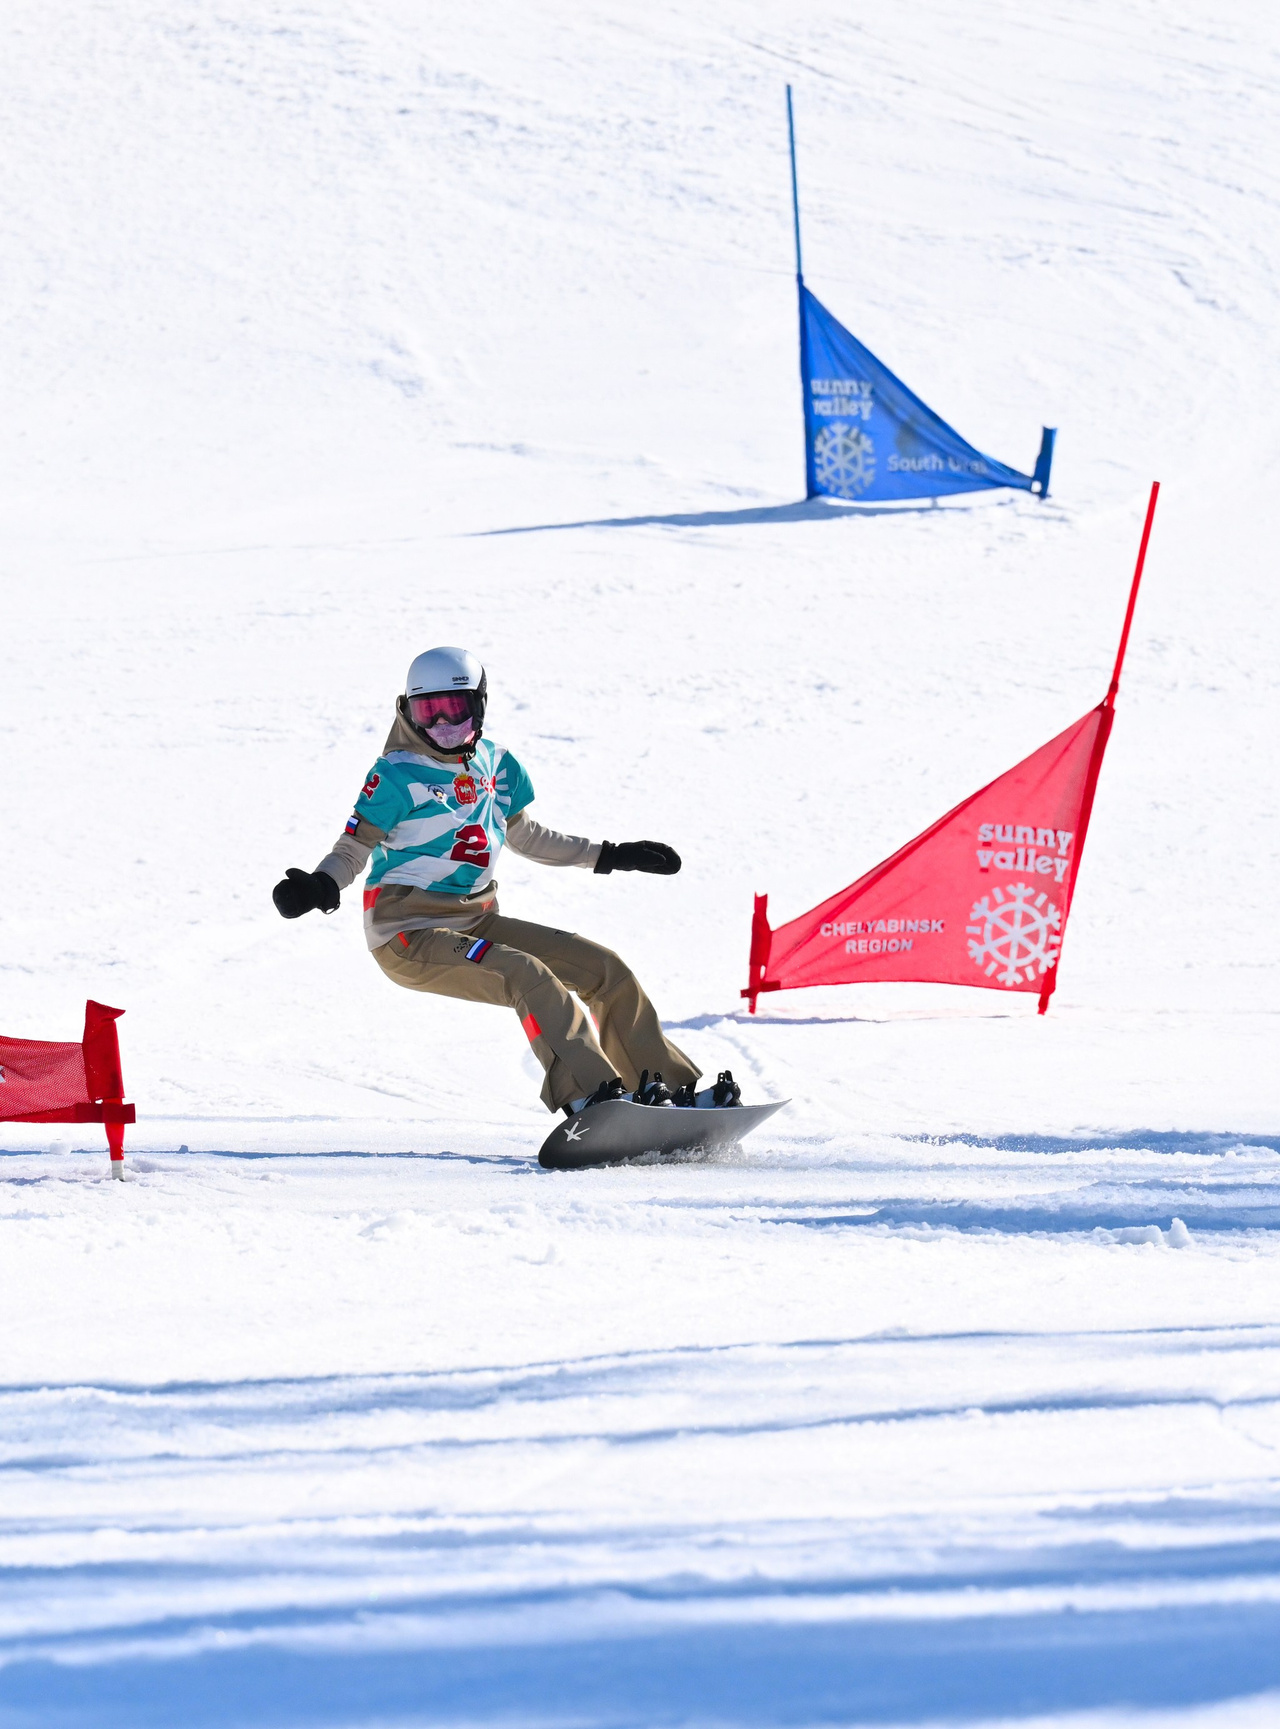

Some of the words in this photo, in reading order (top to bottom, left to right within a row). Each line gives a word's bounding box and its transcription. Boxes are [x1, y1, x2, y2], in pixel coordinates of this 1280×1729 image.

[887, 453, 944, 473] South
[450, 824, 490, 868] 2
[978, 823, 1073, 856] sunny
[977, 847, 1069, 882] valley
[820, 919, 944, 937] CHELYABINSK
[845, 939, 914, 954] REGION
